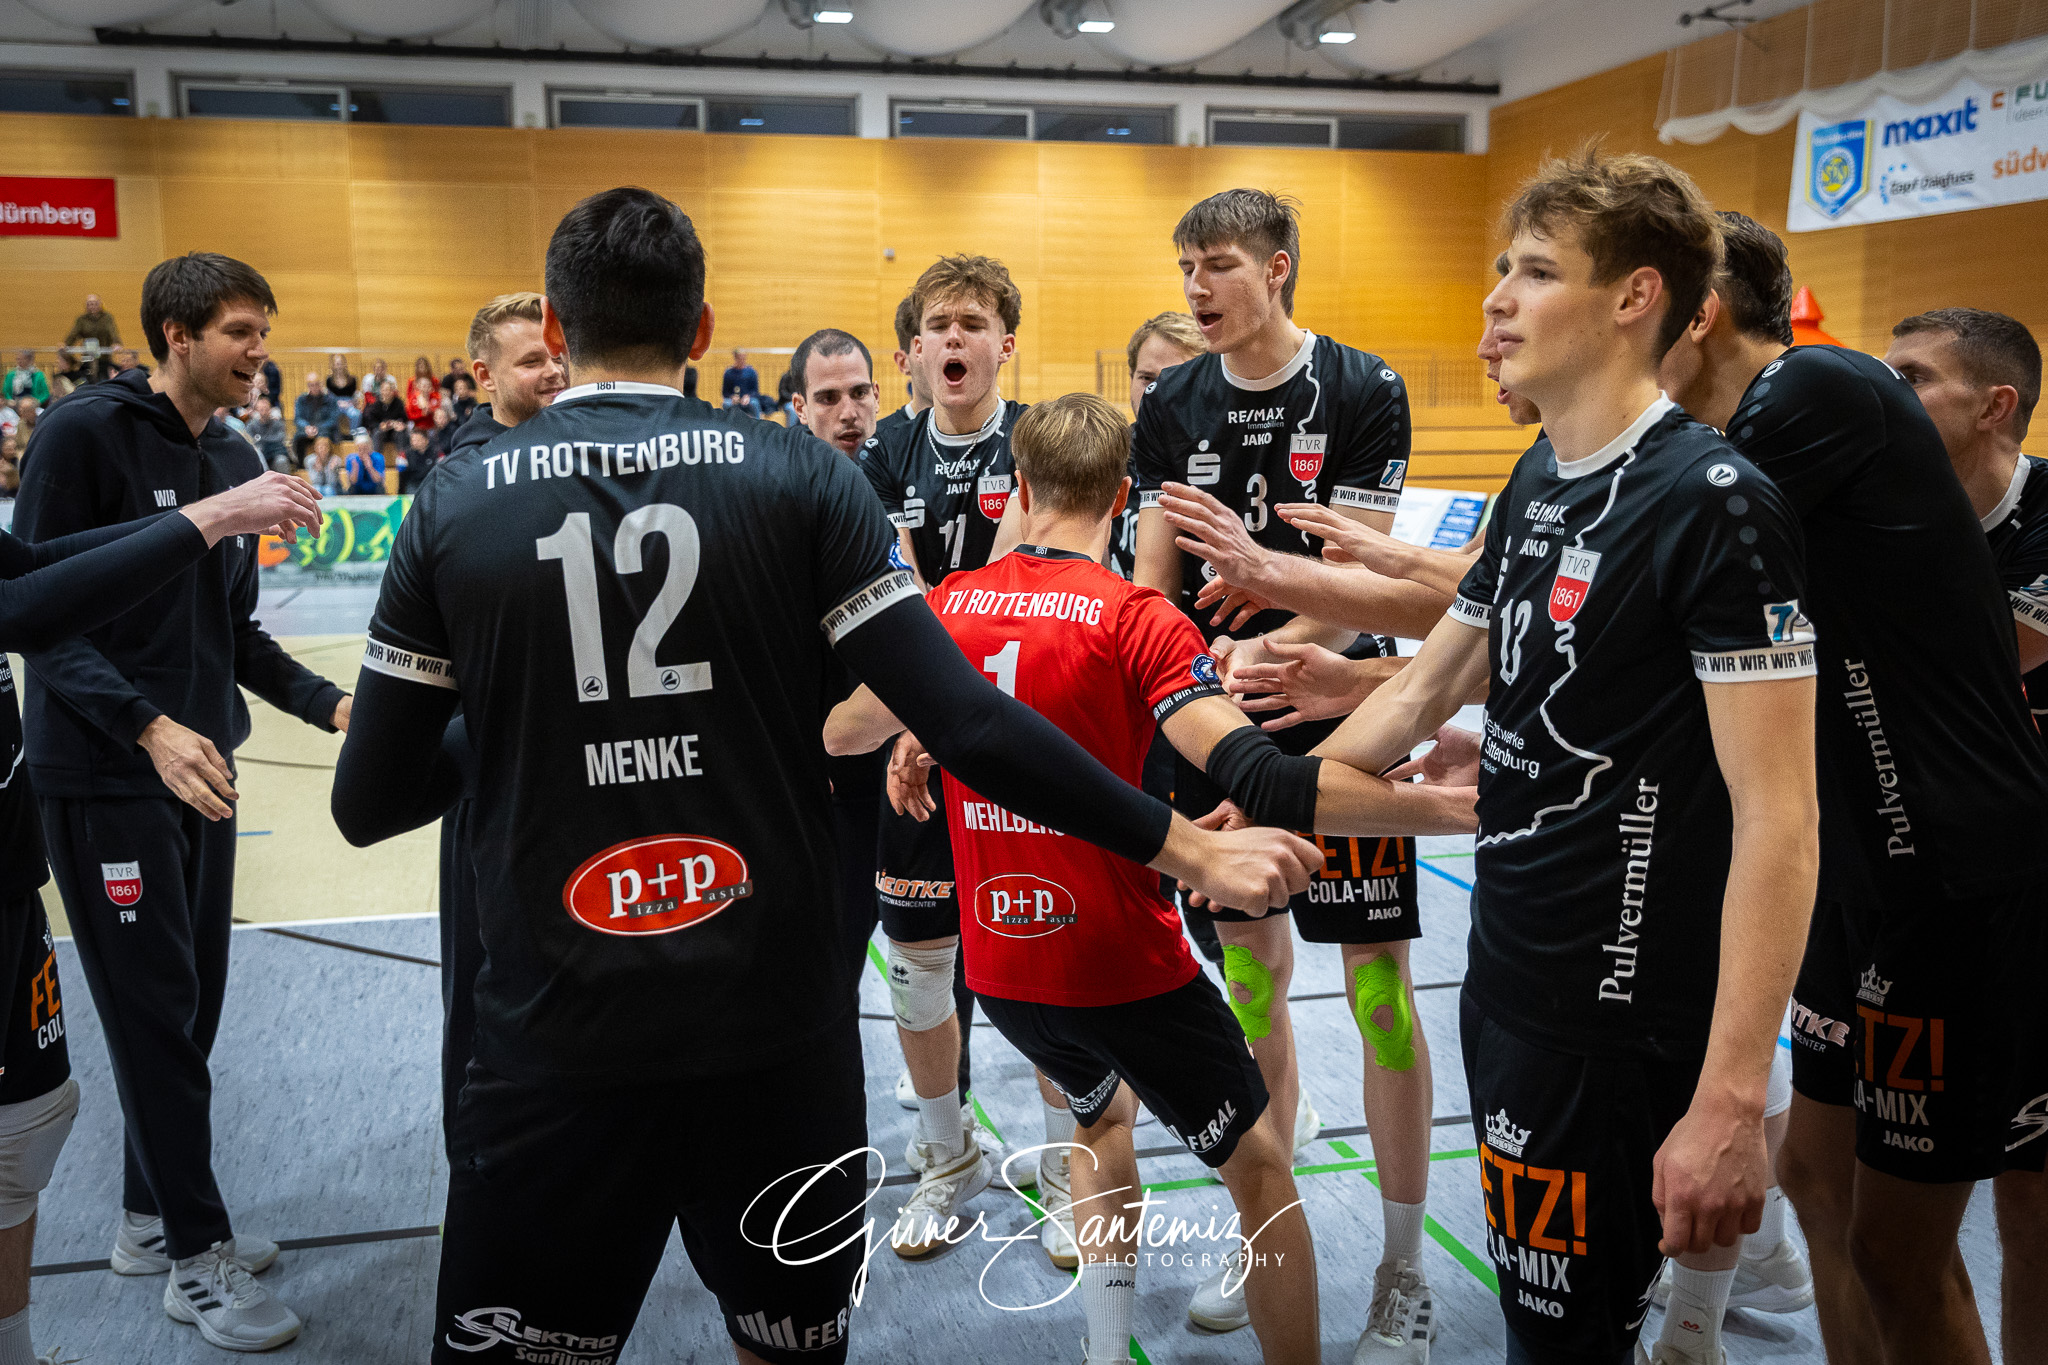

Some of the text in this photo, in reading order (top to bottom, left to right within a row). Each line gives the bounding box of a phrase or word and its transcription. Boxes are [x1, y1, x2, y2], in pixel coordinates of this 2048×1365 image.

[1882, 97, 1978, 147] maxit
[0, 201, 96, 230] ürnberg
[596, 381, 616, 391] 1861
[1228, 407, 1285, 424] RE/MAX
[1242, 432, 1273, 447] JAKO
[1297, 438, 1321, 451] TVR
[483, 430, 744, 490] TV ROTTENBURG
[1294, 459, 1319, 472] 1861
[153, 489, 177, 507] WIR
[983, 480, 1006, 491] TVR
[1340, 489, 1356, 501] WIR
[1358, 492, 1373, 504] WIR
[1373, 494, 1387, 506] WIR
[1244, 473, 1268, 532] 3
[939, 513, 967, 569] 11
[1567, 555, 1591, 576] TVR
[536, 503, 713, 702] 12
[827, 609, 849, 631] WIR
[844, 593, 872, 617] WIR
[869, 579, 896, 601] WIR
[942, 589, 1104, 626] TV ROTTENBURG
[1464, 603, 1484, 619] WIR
[1553, 587, 1580, 609] 1861
[2011, 596, 2035, 616] WIR
[386, 648, 413, 669] WIR
[416, 656, 443, 676] WIR
[983, 640, 1022, 700] 1
[1709, 656, 1736, 672] WIR
[1739, 654, 1768, 671] WIR
[1770, 652, 1797, 669] WIR
[585, 734, 703, 786] MENKE
[1843, 658, 1916, 859] Pulvermüller
[107, 866, 134, 878] TVR
[606, 853, 716, 919] p+p
[110, 884, 138, 897] 1861
[1308, 877, 1399, 903] COLA-MIX
[1600, 777, 1660, 1004] Pulvermüller
[119, 910, 137, 924] FW
[990, 889, 1054, 921] p+p
[1366, 906, 1402, 920] JAKO
[31, 949, 60, 1031] FE
[38, 1013, 65, 1049] COL
[1856, 1003, 1945, 1092] TZ!
[1187, 1099, 1236, 1150] FERAL
[1883, 1130, 1934, 1153] JAKO
[1517, 1289, 1565, 1318] JAKO
